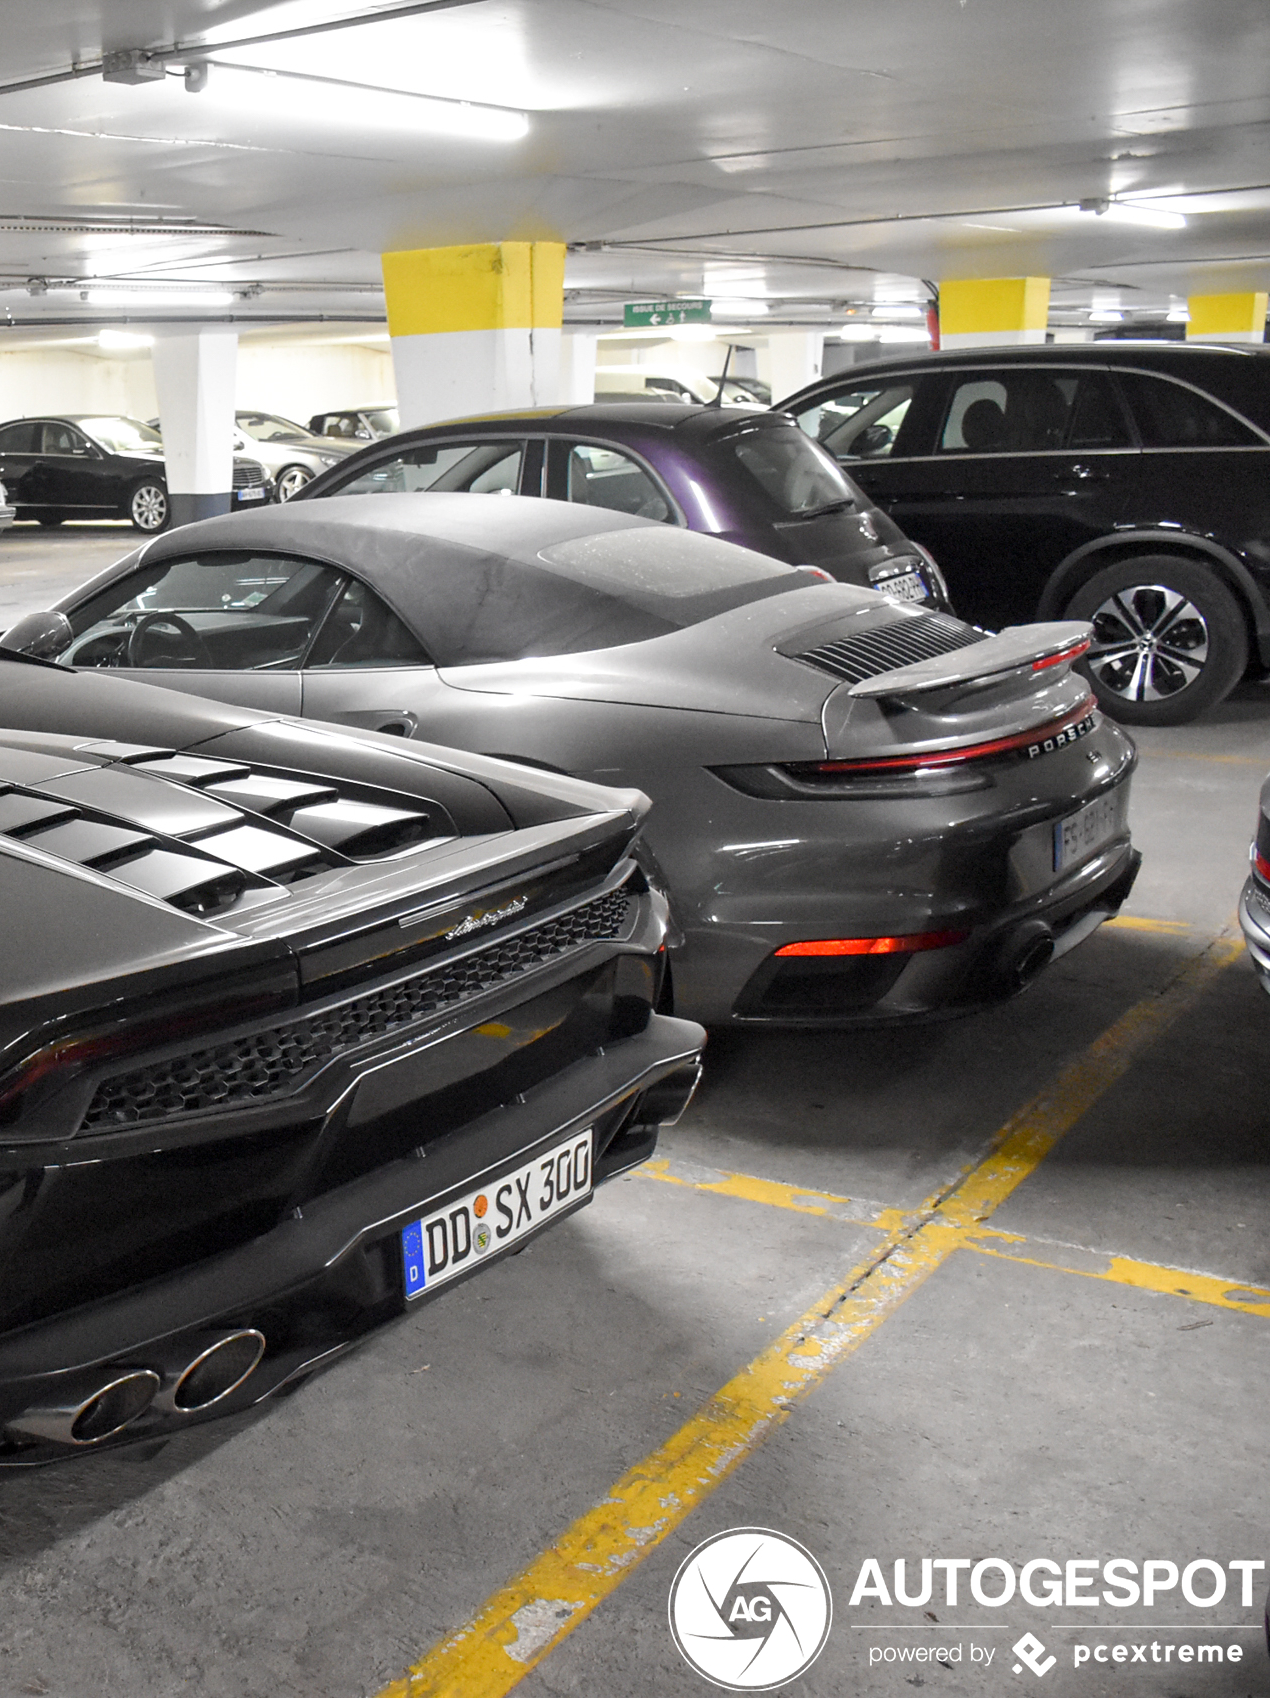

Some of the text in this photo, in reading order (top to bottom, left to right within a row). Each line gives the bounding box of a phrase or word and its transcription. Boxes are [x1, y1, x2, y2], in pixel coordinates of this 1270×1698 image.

[632, 301, 704, 313] ISSUE DE SECOURS
[425, 1139, 589, 1277] DD SX 300
[409, 1265, 419, 1283] D
